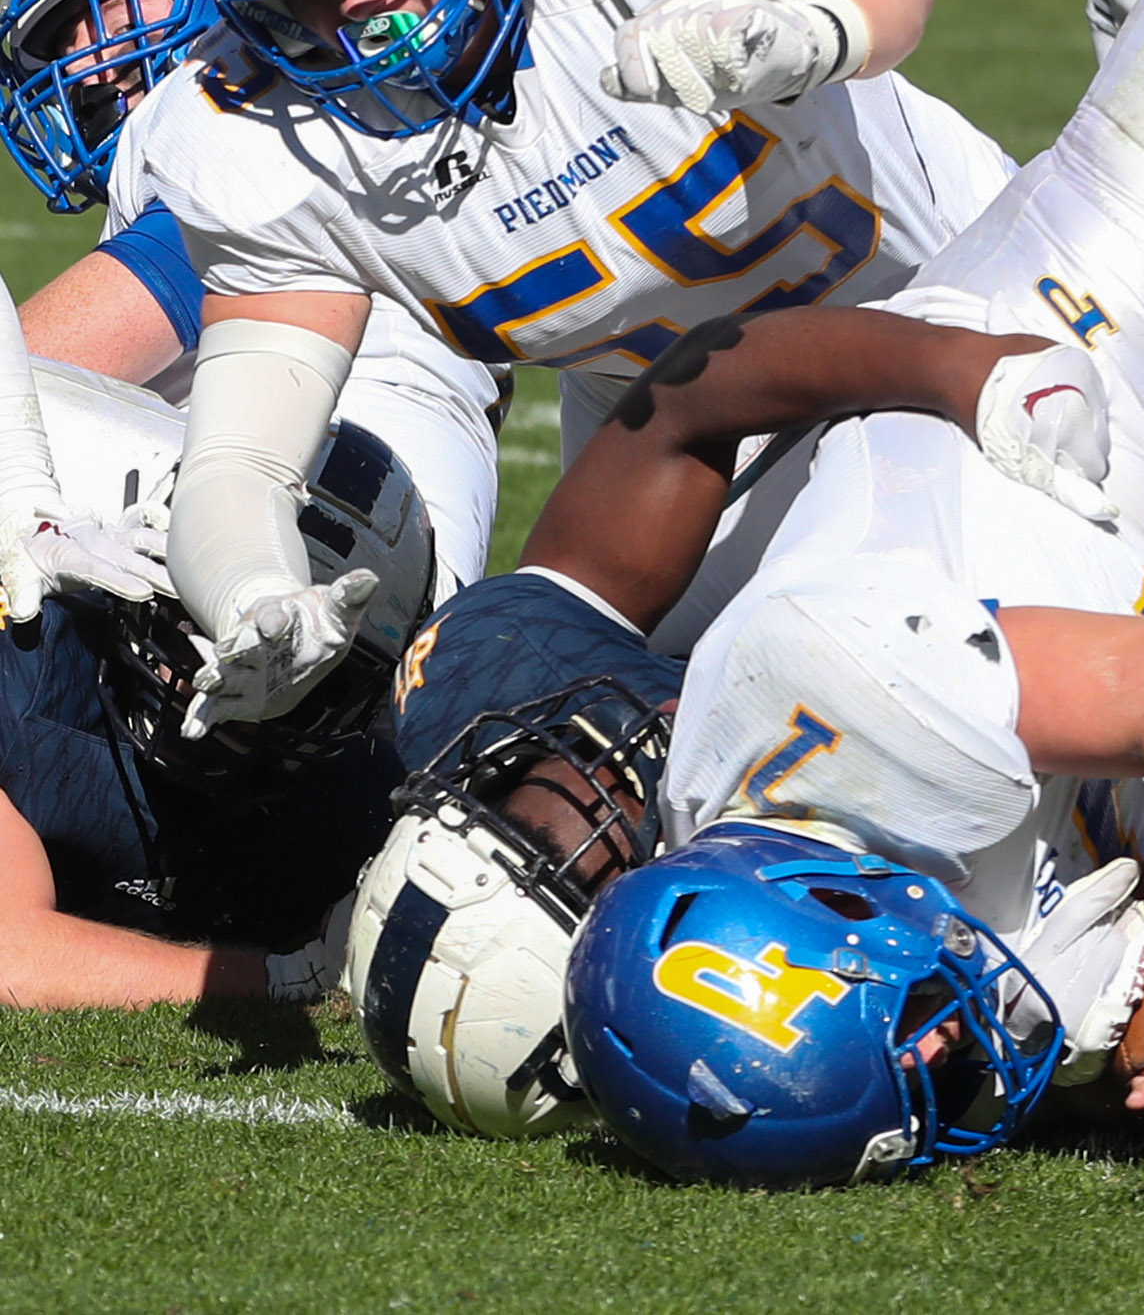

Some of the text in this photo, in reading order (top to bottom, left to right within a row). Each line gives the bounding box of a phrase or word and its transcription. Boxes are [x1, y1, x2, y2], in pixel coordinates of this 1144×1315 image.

[433, 170, 492, 204] RUSSELL
[493, 125, 637, 234] PIEDMONT
[424, 109, 882, 370] 55
[1033, 273, 1121, 351] P
[652, 940, 852, 1054] P
